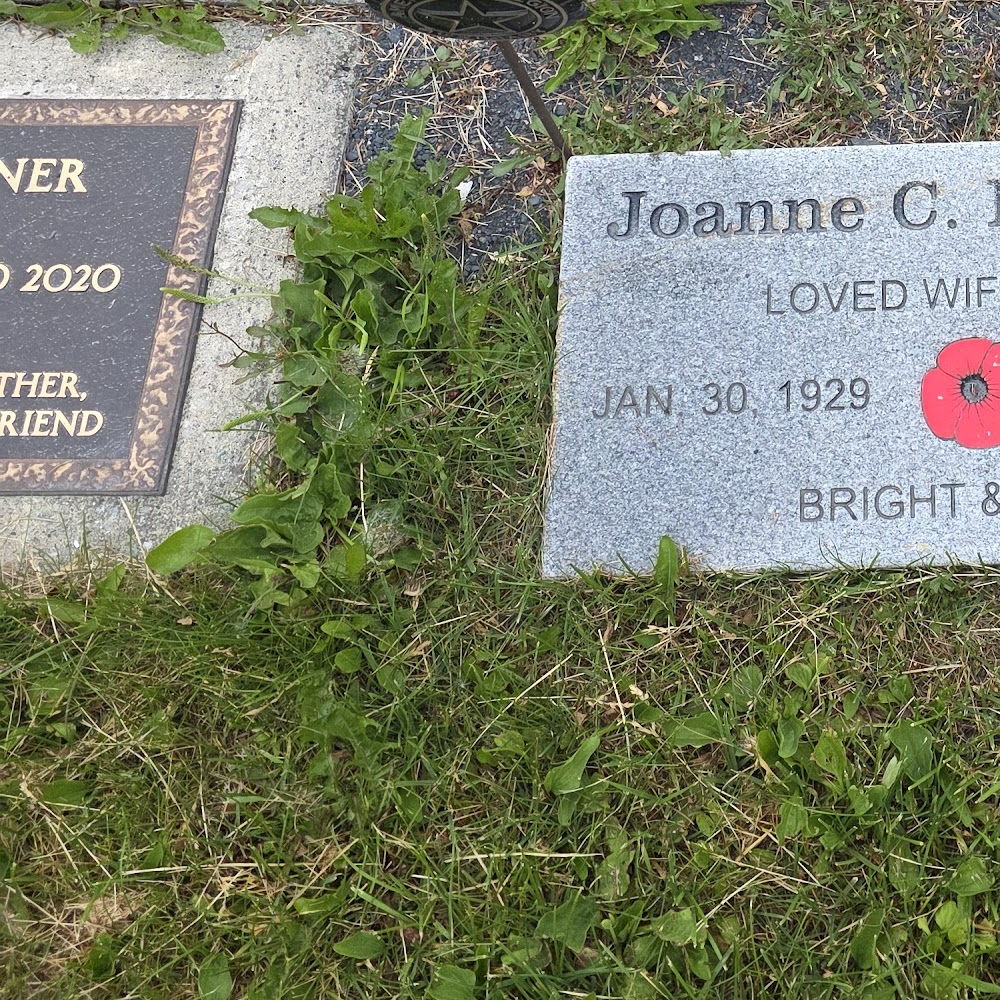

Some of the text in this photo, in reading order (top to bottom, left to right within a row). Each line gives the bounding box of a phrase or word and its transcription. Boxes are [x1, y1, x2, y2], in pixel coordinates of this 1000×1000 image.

[606, 190, 867, 242] Joanne
[892, 180, 957, 231] C.
[19, 263, 122, 293] 2020
[766, 279, 908, 315] LOVED
[591, 384, 684, 420] JAN.
[702, 382, 758, 419] 30,
[778, 377, 870, 413] 1929
[0, 410, 104, 437] RIEND
[800, 483, 966, 523] BRIGHT
